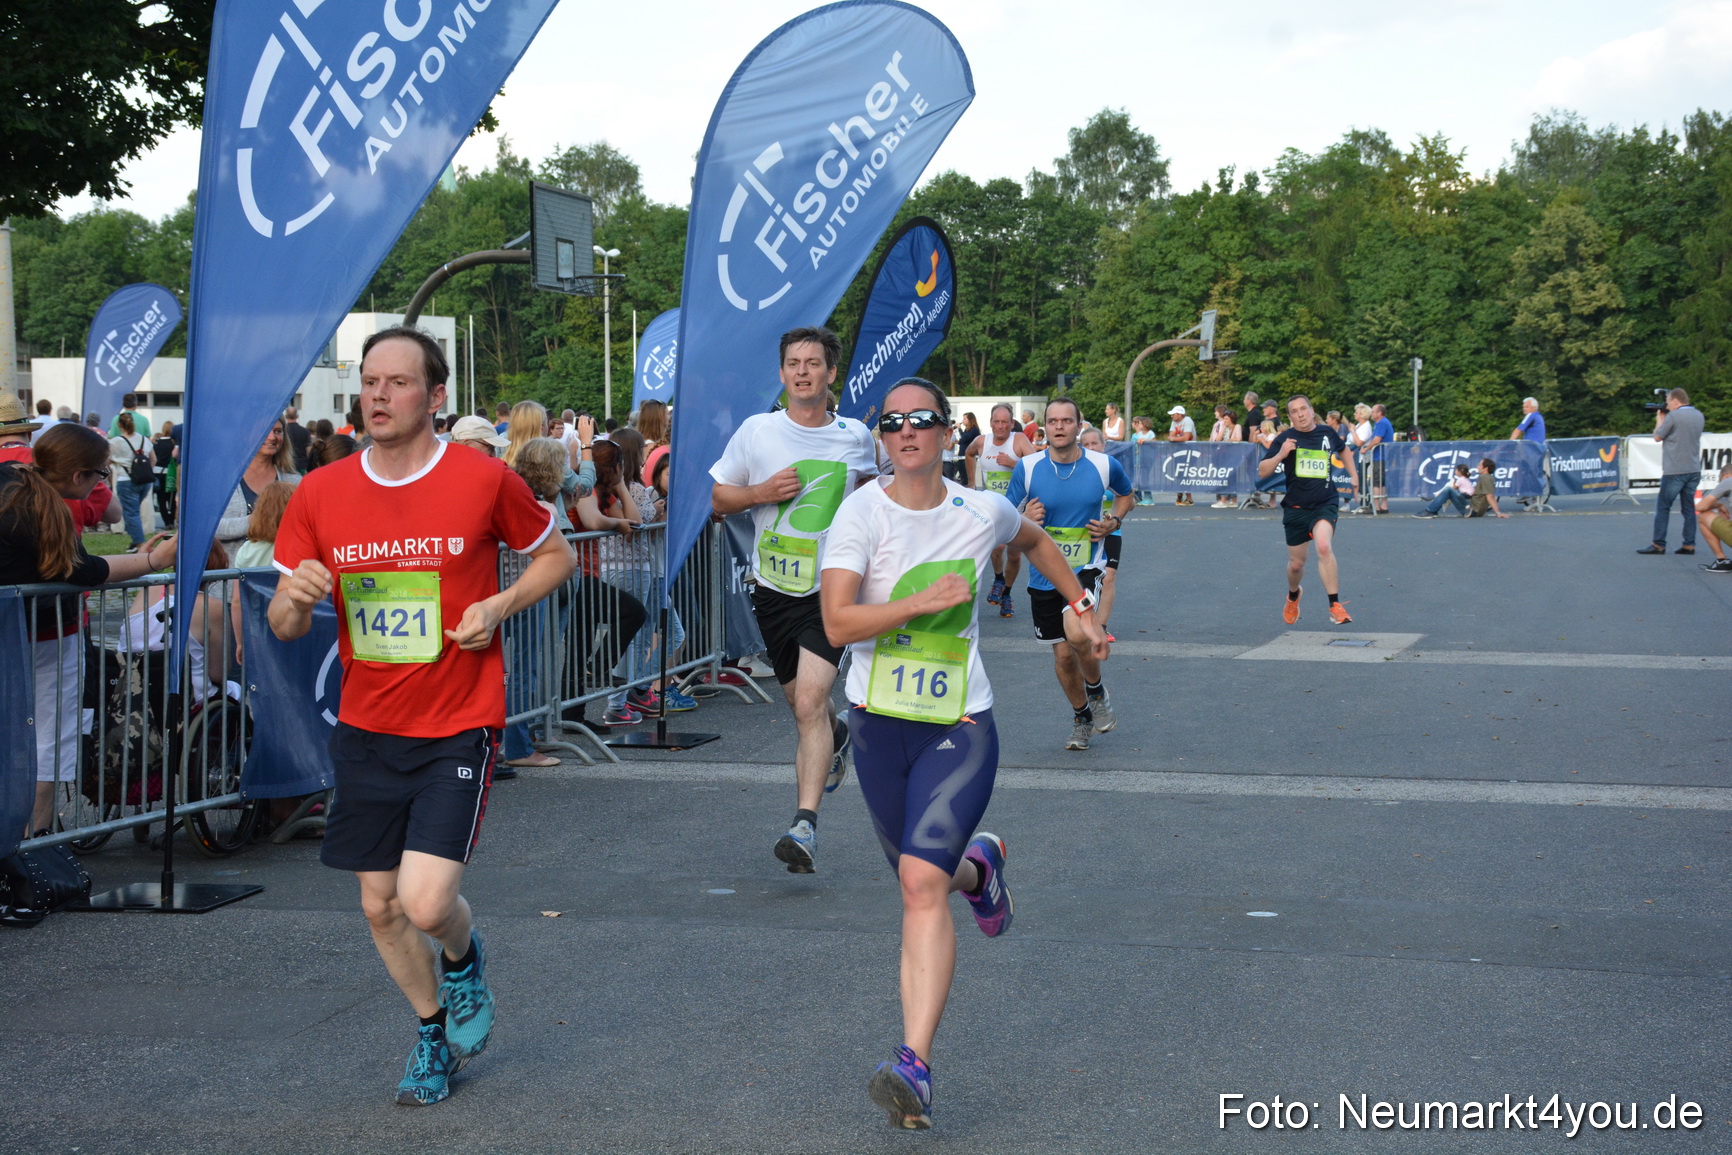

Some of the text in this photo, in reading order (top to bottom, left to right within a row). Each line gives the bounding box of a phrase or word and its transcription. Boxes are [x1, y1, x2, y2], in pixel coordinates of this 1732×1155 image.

[754, 50, 911, 273] Fischer
[809, 93, 929, 270] AUTOMOBILE
[107, 300, 161, 374] Fischer
[896, 335, 915, 362] Druck
[927, 290, 950, 326] Medien
[127, 314, 168, 373] AUTOMOBILE
[848, 302, 924, 404] Frischmann
[1175, 463, 1234, 478] Fischer
[1300, 460, 1325, 470] 1160
[1550, 456, 1602, 472] Frischmann
[992, 482, 1009, 490] 542
[333, 537, 442, 564] NEUMARKT
[397, 560, 420, 568] STARKE
[769, 555, 800, 578] 111
[355, 608, 427, 637] 1421
[891, 665, 948, 698] 116
[910, 701, 936, 710] Marquart
